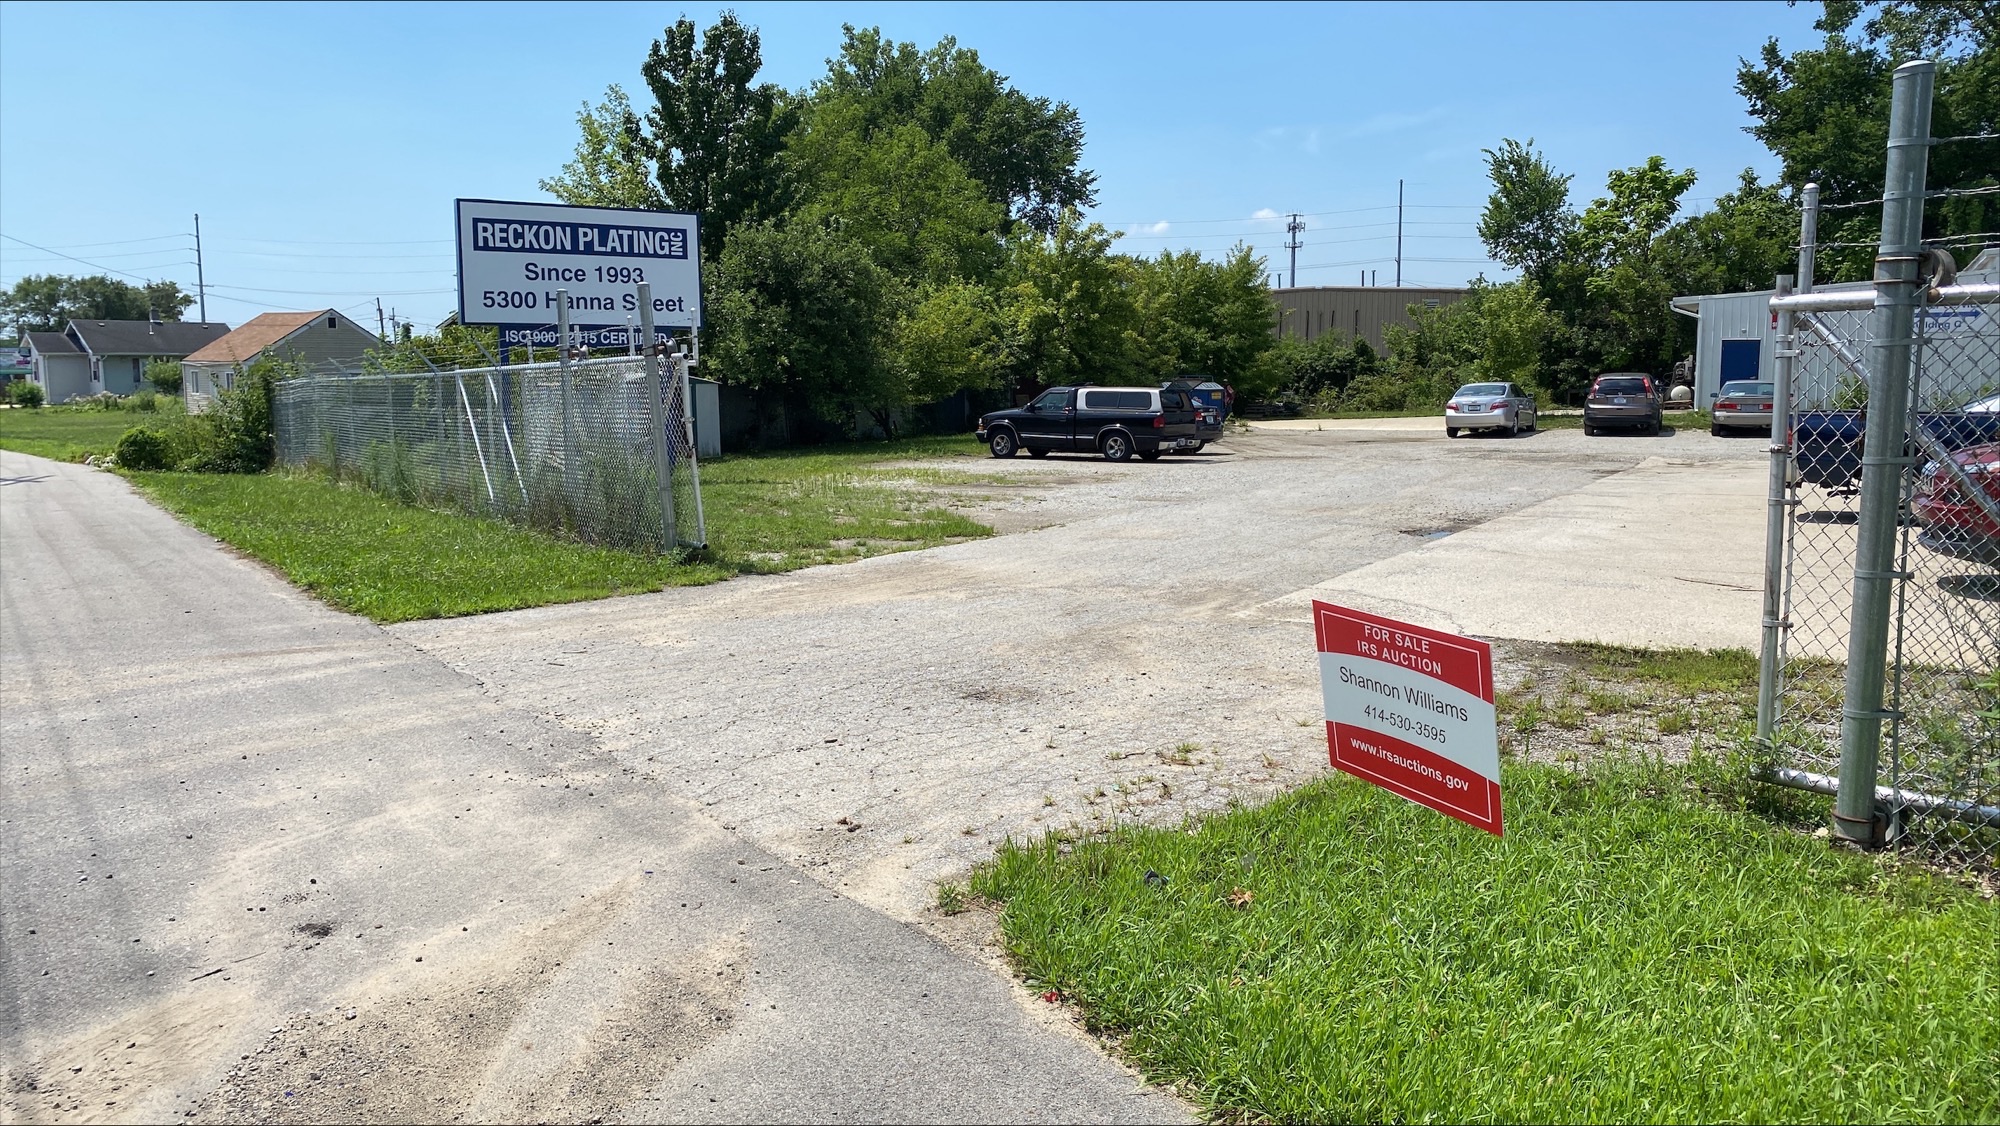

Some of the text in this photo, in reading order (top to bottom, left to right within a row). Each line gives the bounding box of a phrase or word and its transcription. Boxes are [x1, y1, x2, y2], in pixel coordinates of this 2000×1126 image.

[477, 222, 670, 255] RECKON PLATING
[670, 231, 683, 256] INC
[524, 262, 645, 284] Since 1993
[482, 290, 684, 313] 5300 Hanna Seet
[1364, 624, 1430, 654] FOR SALE
[1357, 640, 1442, 676] IRS AUCTION
[1339, 666, 1468, 722] Shannon Williams
[1364, 704, 1446, 744] 414-530-3595
[1350, 737, 1469, 792] www.irsauctions.gov
